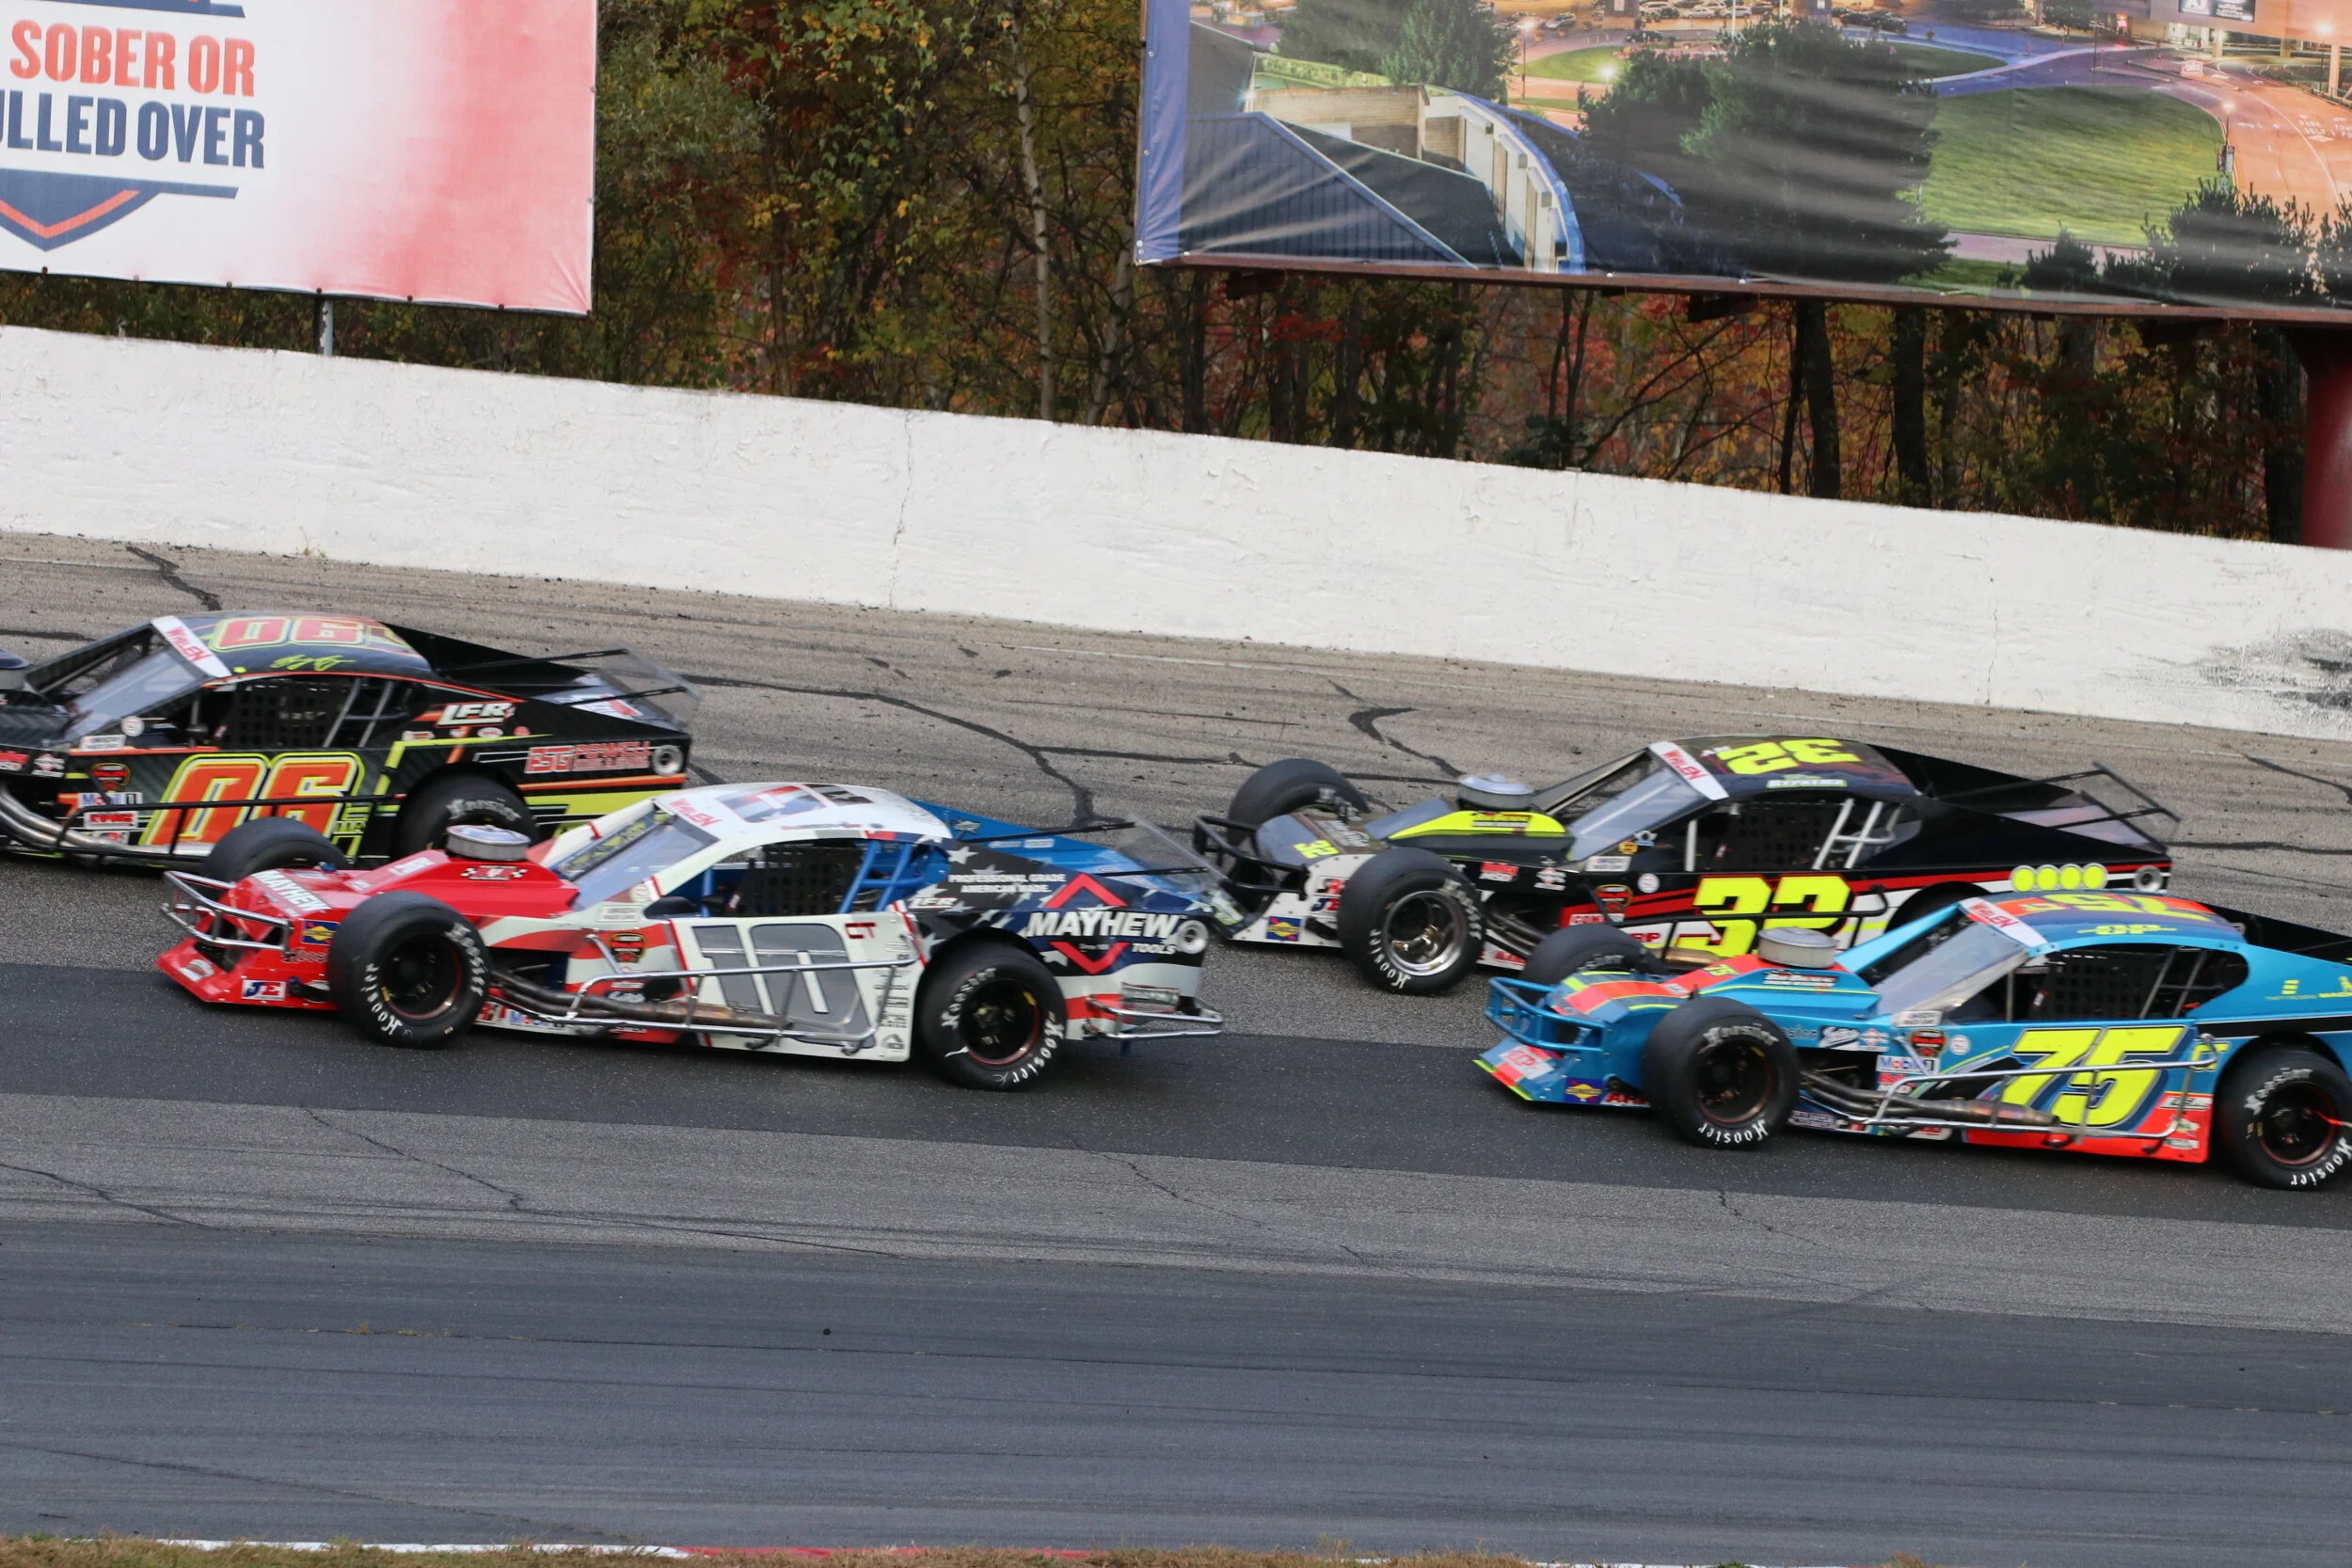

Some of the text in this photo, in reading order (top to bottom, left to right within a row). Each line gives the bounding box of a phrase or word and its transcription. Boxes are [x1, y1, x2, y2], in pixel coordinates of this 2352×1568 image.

[9, 19, 255, 97] SOBER OR
[0, 89, 264, 169] LLED OVER
[166, 626, 213, 663] WHELEN
[437, 703, 513, 727] LFR
[1661, 749, 1708, 782] WHELEN
[1716, 738, 1862, 775] 32
[139, 752, 366, 847] 06
[668, 800, 723, 827] WHELEN
[1293, 840, 1341, 860] 32
[250, 870, 332, 912] MAYHEW
[948, 874, 1067, 883] PROFESSIONAL GRADE
[845, 922, 876, 940] CT
[1026, 911, 1181, 939] MAYHEW
[1669, 874, 1855, 958] 32
[1967, 903, 2021, 928] WHELEN
[1132, 942, 1176, 955] TOOLS
[1703, 963, 1740, 977] 75
[364, 962, 404, 1036] Hoosier
[1010, 1019, 1064, 1085] Hoosier
[2010, 1025, 2188, 1128] 75
[1698, 1117, 1770, 1145] Hoosier
[2290, 1136, 2352, 1188] Hoosier
